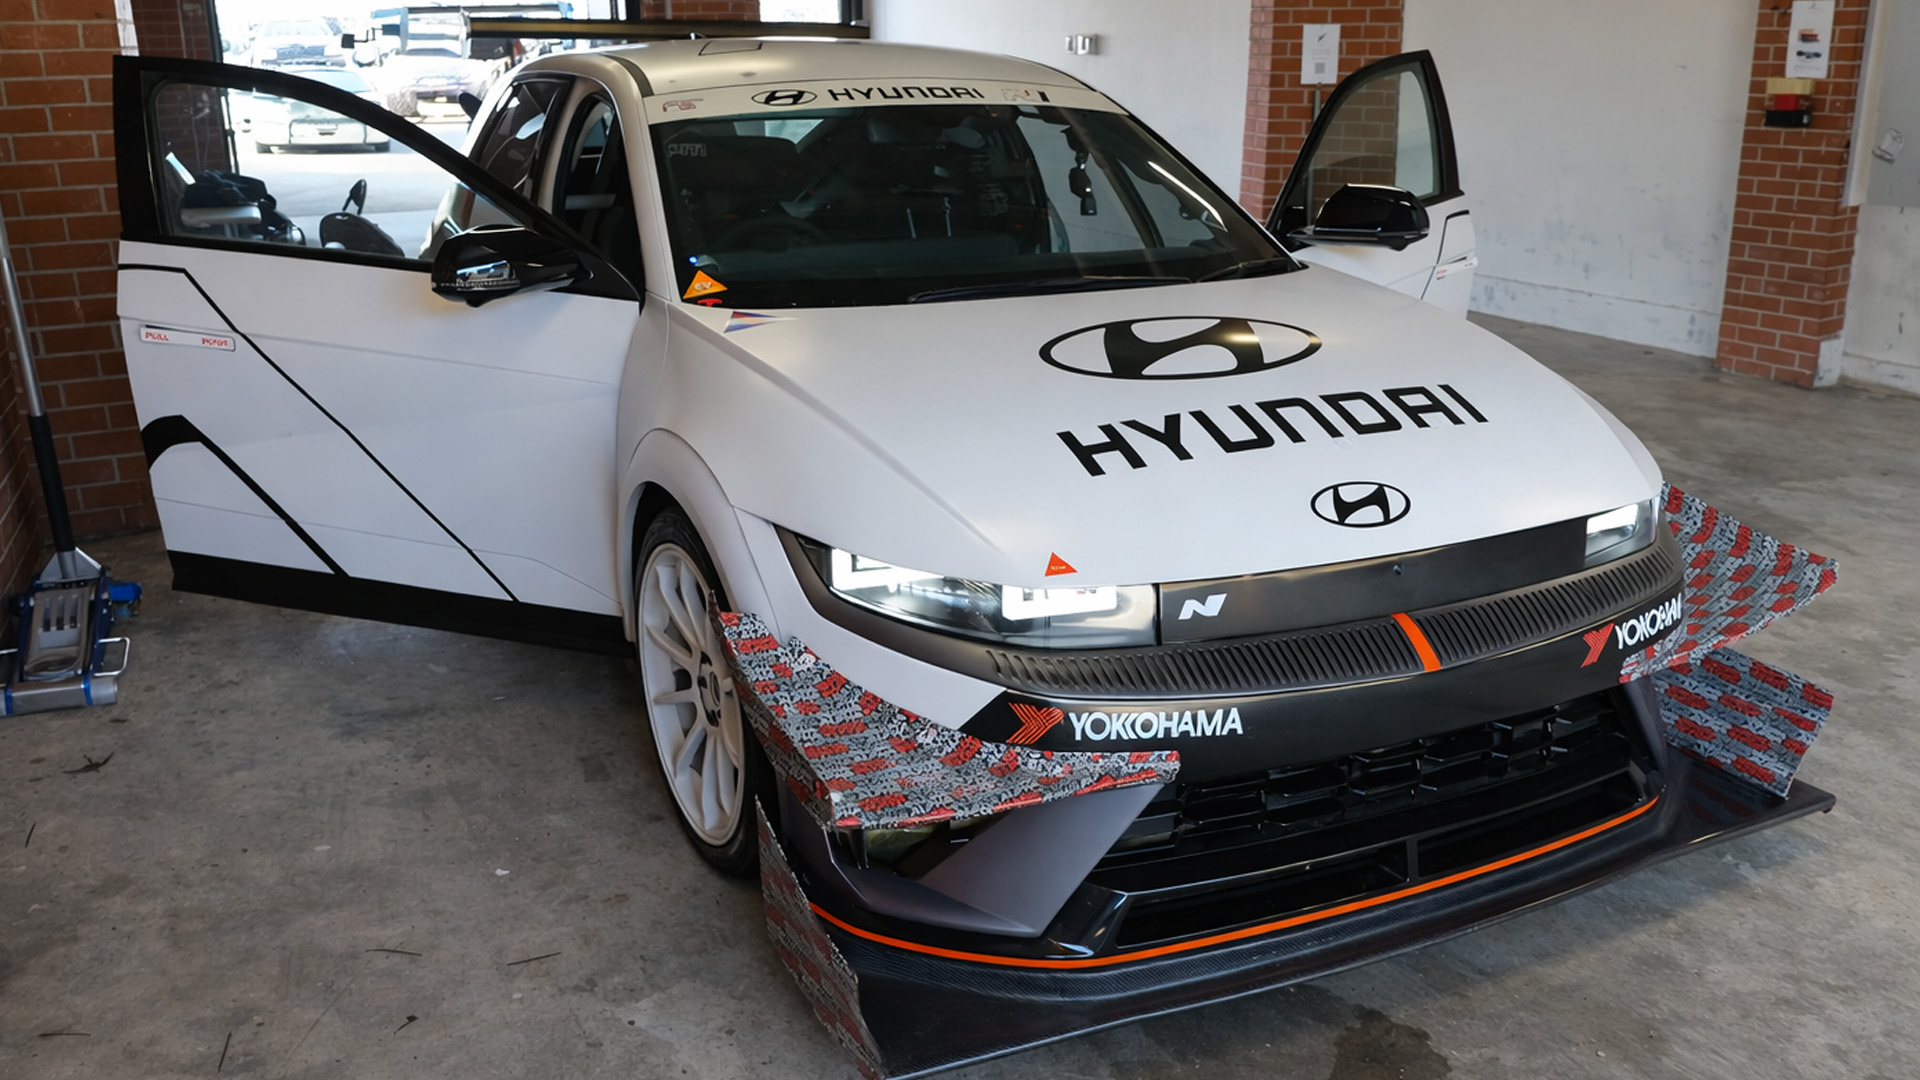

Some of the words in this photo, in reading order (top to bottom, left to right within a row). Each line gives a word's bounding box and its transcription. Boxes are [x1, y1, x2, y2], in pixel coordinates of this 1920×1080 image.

[828, 86, 985, 101] HYUNDAI
[1056, 384, 1489, 477] HYUNDAI
[1068, 707, 1244, 741] YOKOHAMA
